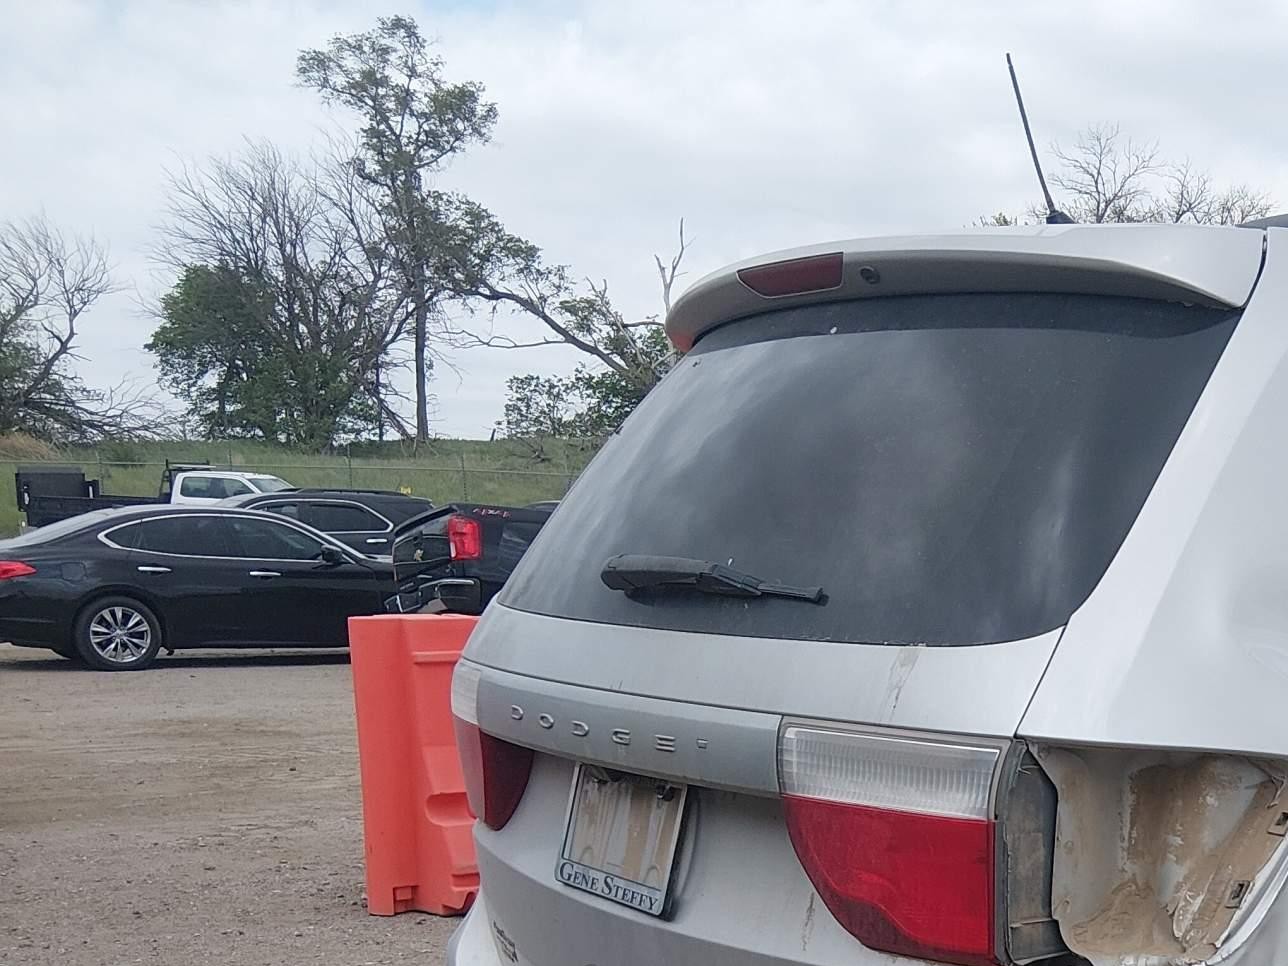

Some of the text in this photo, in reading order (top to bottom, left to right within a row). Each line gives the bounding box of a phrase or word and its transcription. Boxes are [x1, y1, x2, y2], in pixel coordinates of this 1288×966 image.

[511, 704, 676, 752] DODGE
[560, 862, 658, 910] GENE STEFFY
